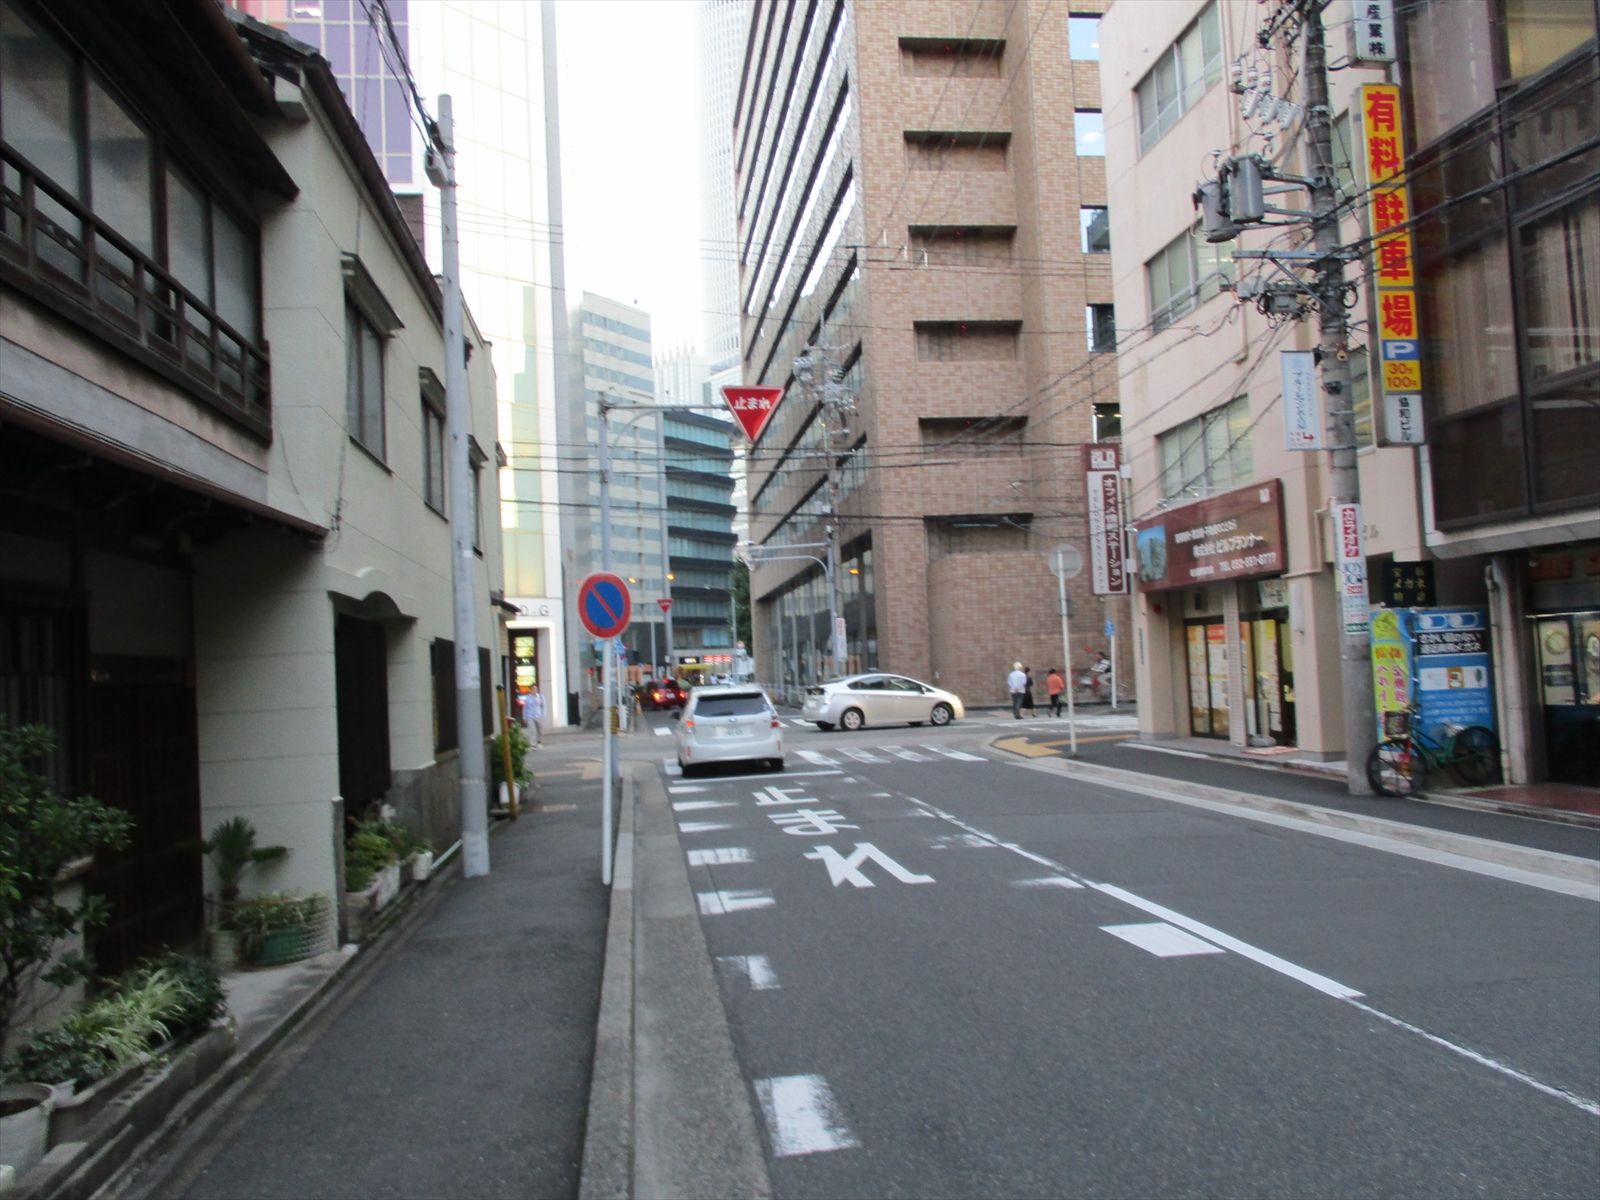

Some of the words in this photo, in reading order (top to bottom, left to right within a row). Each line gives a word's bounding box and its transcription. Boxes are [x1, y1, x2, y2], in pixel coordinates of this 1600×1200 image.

[1367, 0, 1386, 56] 産業株
[1366, 91, 1413, 337] 有料駐車場
[1386, 341, 1416, 359] P
[734, 396, 773, 410] 止まれ
[752, 786, 936, 888] 止まれ
